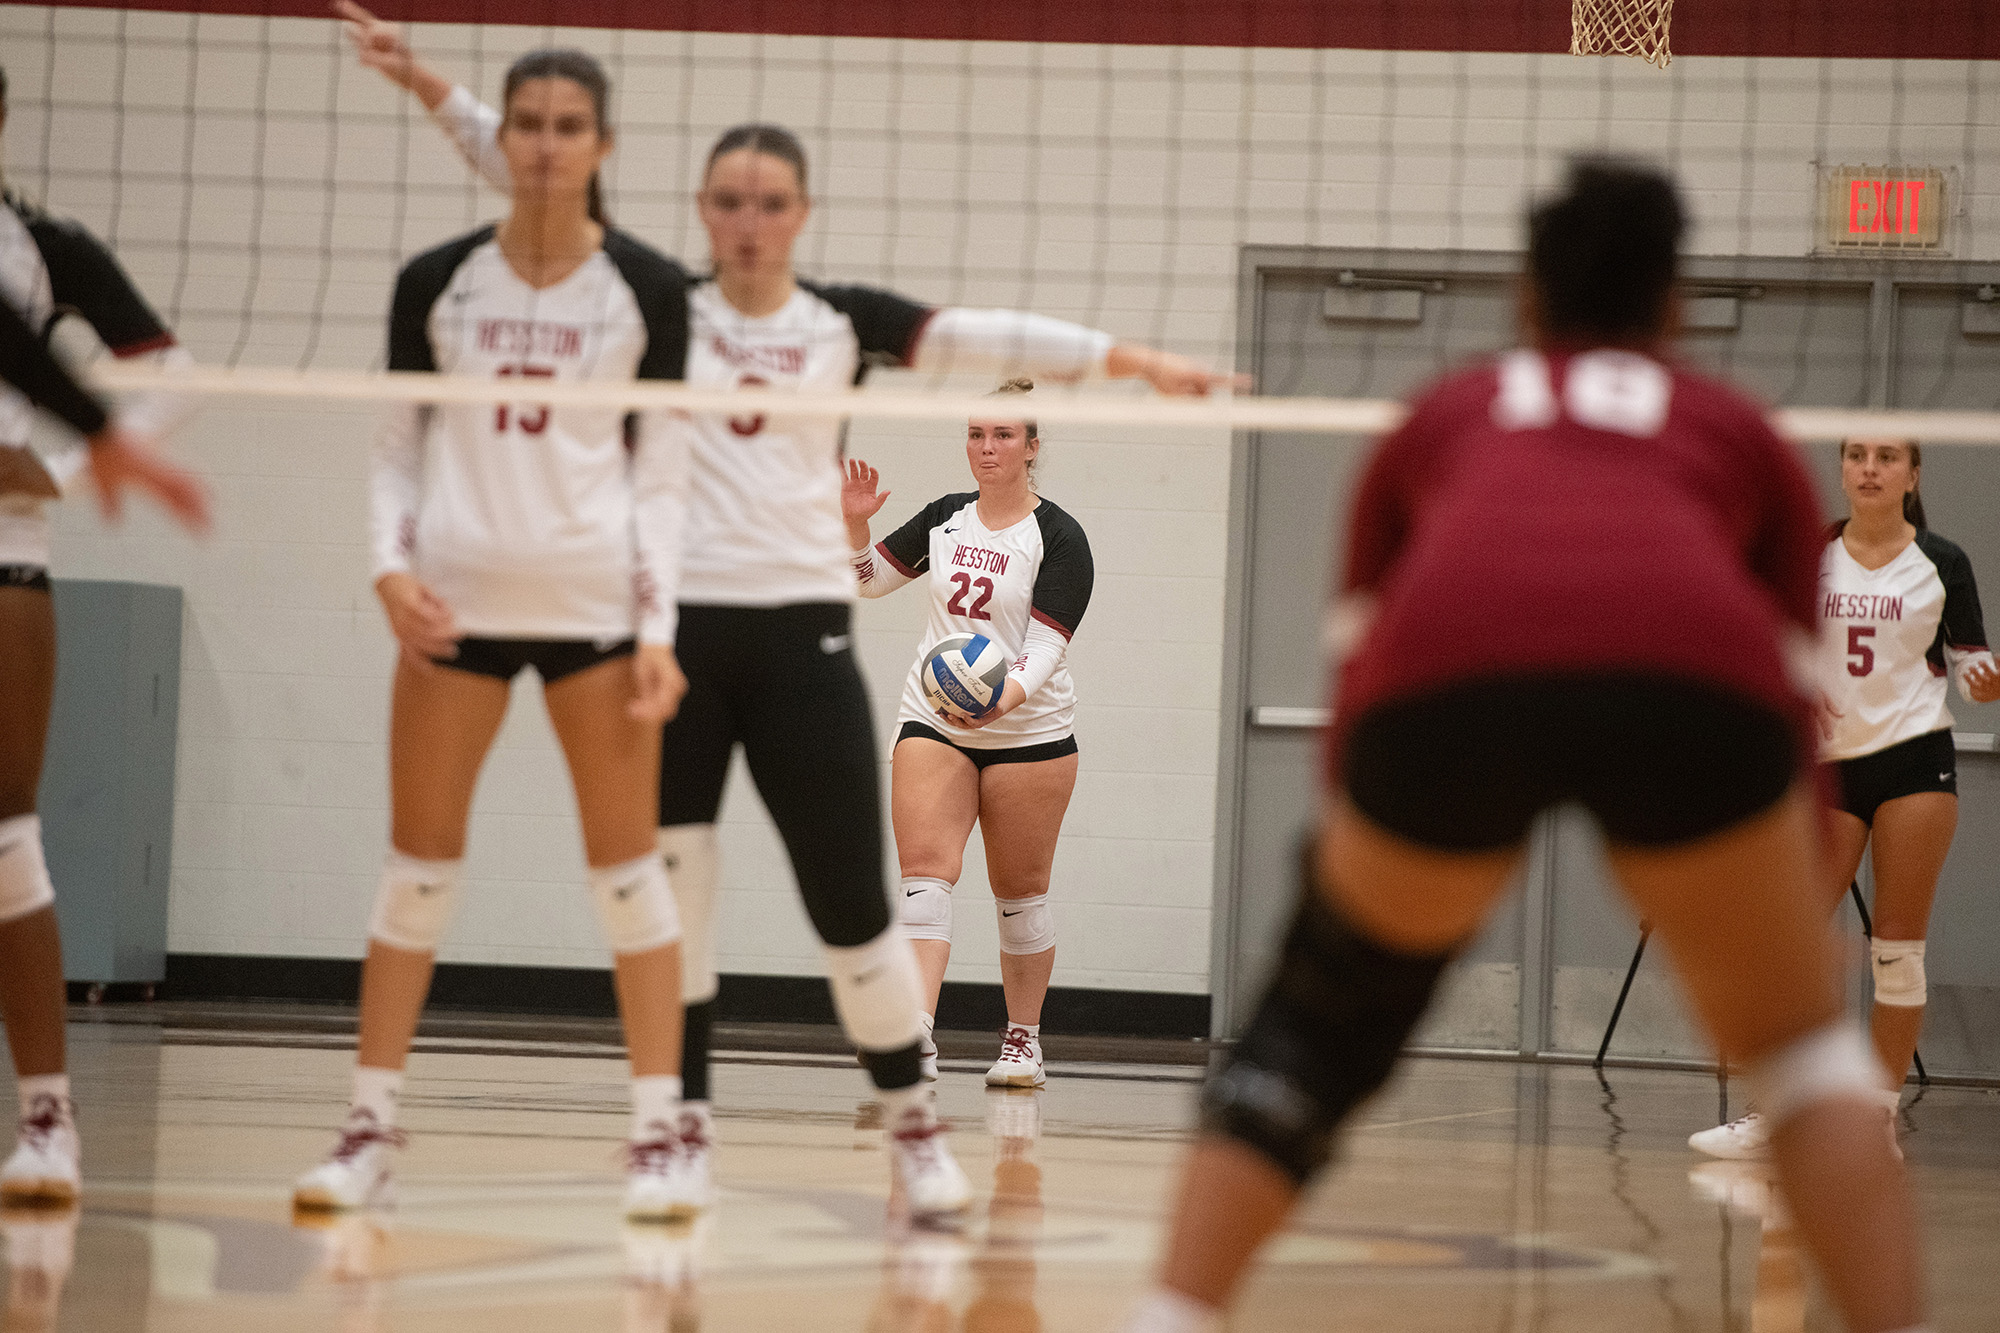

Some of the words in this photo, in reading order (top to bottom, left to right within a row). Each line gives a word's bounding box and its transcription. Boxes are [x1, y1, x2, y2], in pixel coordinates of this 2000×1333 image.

[1848, 180, 1926, 235] EXIT
[951, 544, 1010, 576] HESSTON
[947, 571, 994, 621] 22
[1824, 593, 1903, 621] HESSTON
[1846, 625, 1876, 677] 5
[937, 667, 974, 708] molten
